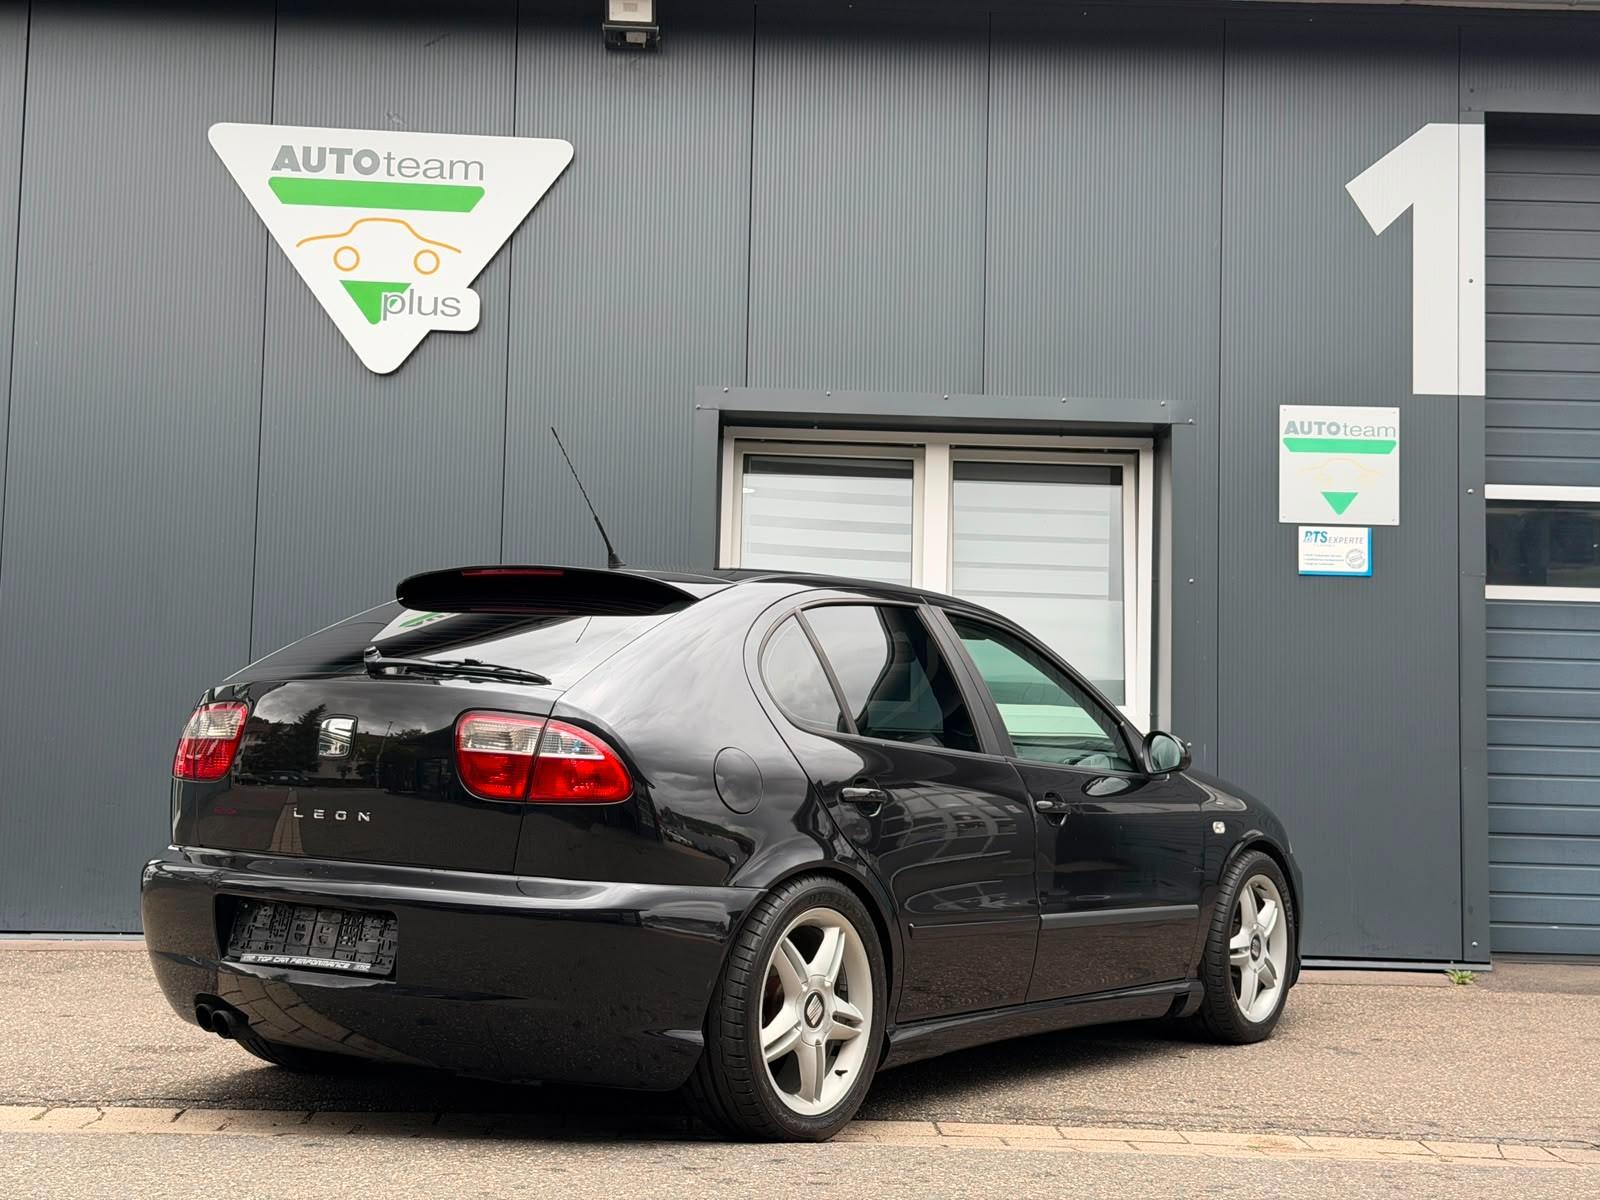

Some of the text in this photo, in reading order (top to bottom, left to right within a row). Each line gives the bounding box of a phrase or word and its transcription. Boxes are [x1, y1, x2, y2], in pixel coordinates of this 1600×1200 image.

[271, 144, 485, 181] AUTOteam
[1345, 123, 1485, 396] 1
[382, 288, 462, 321] plus
[1284, 420, 1396, 438] AUTOteam
[293, 807, 371, 822] LEON
